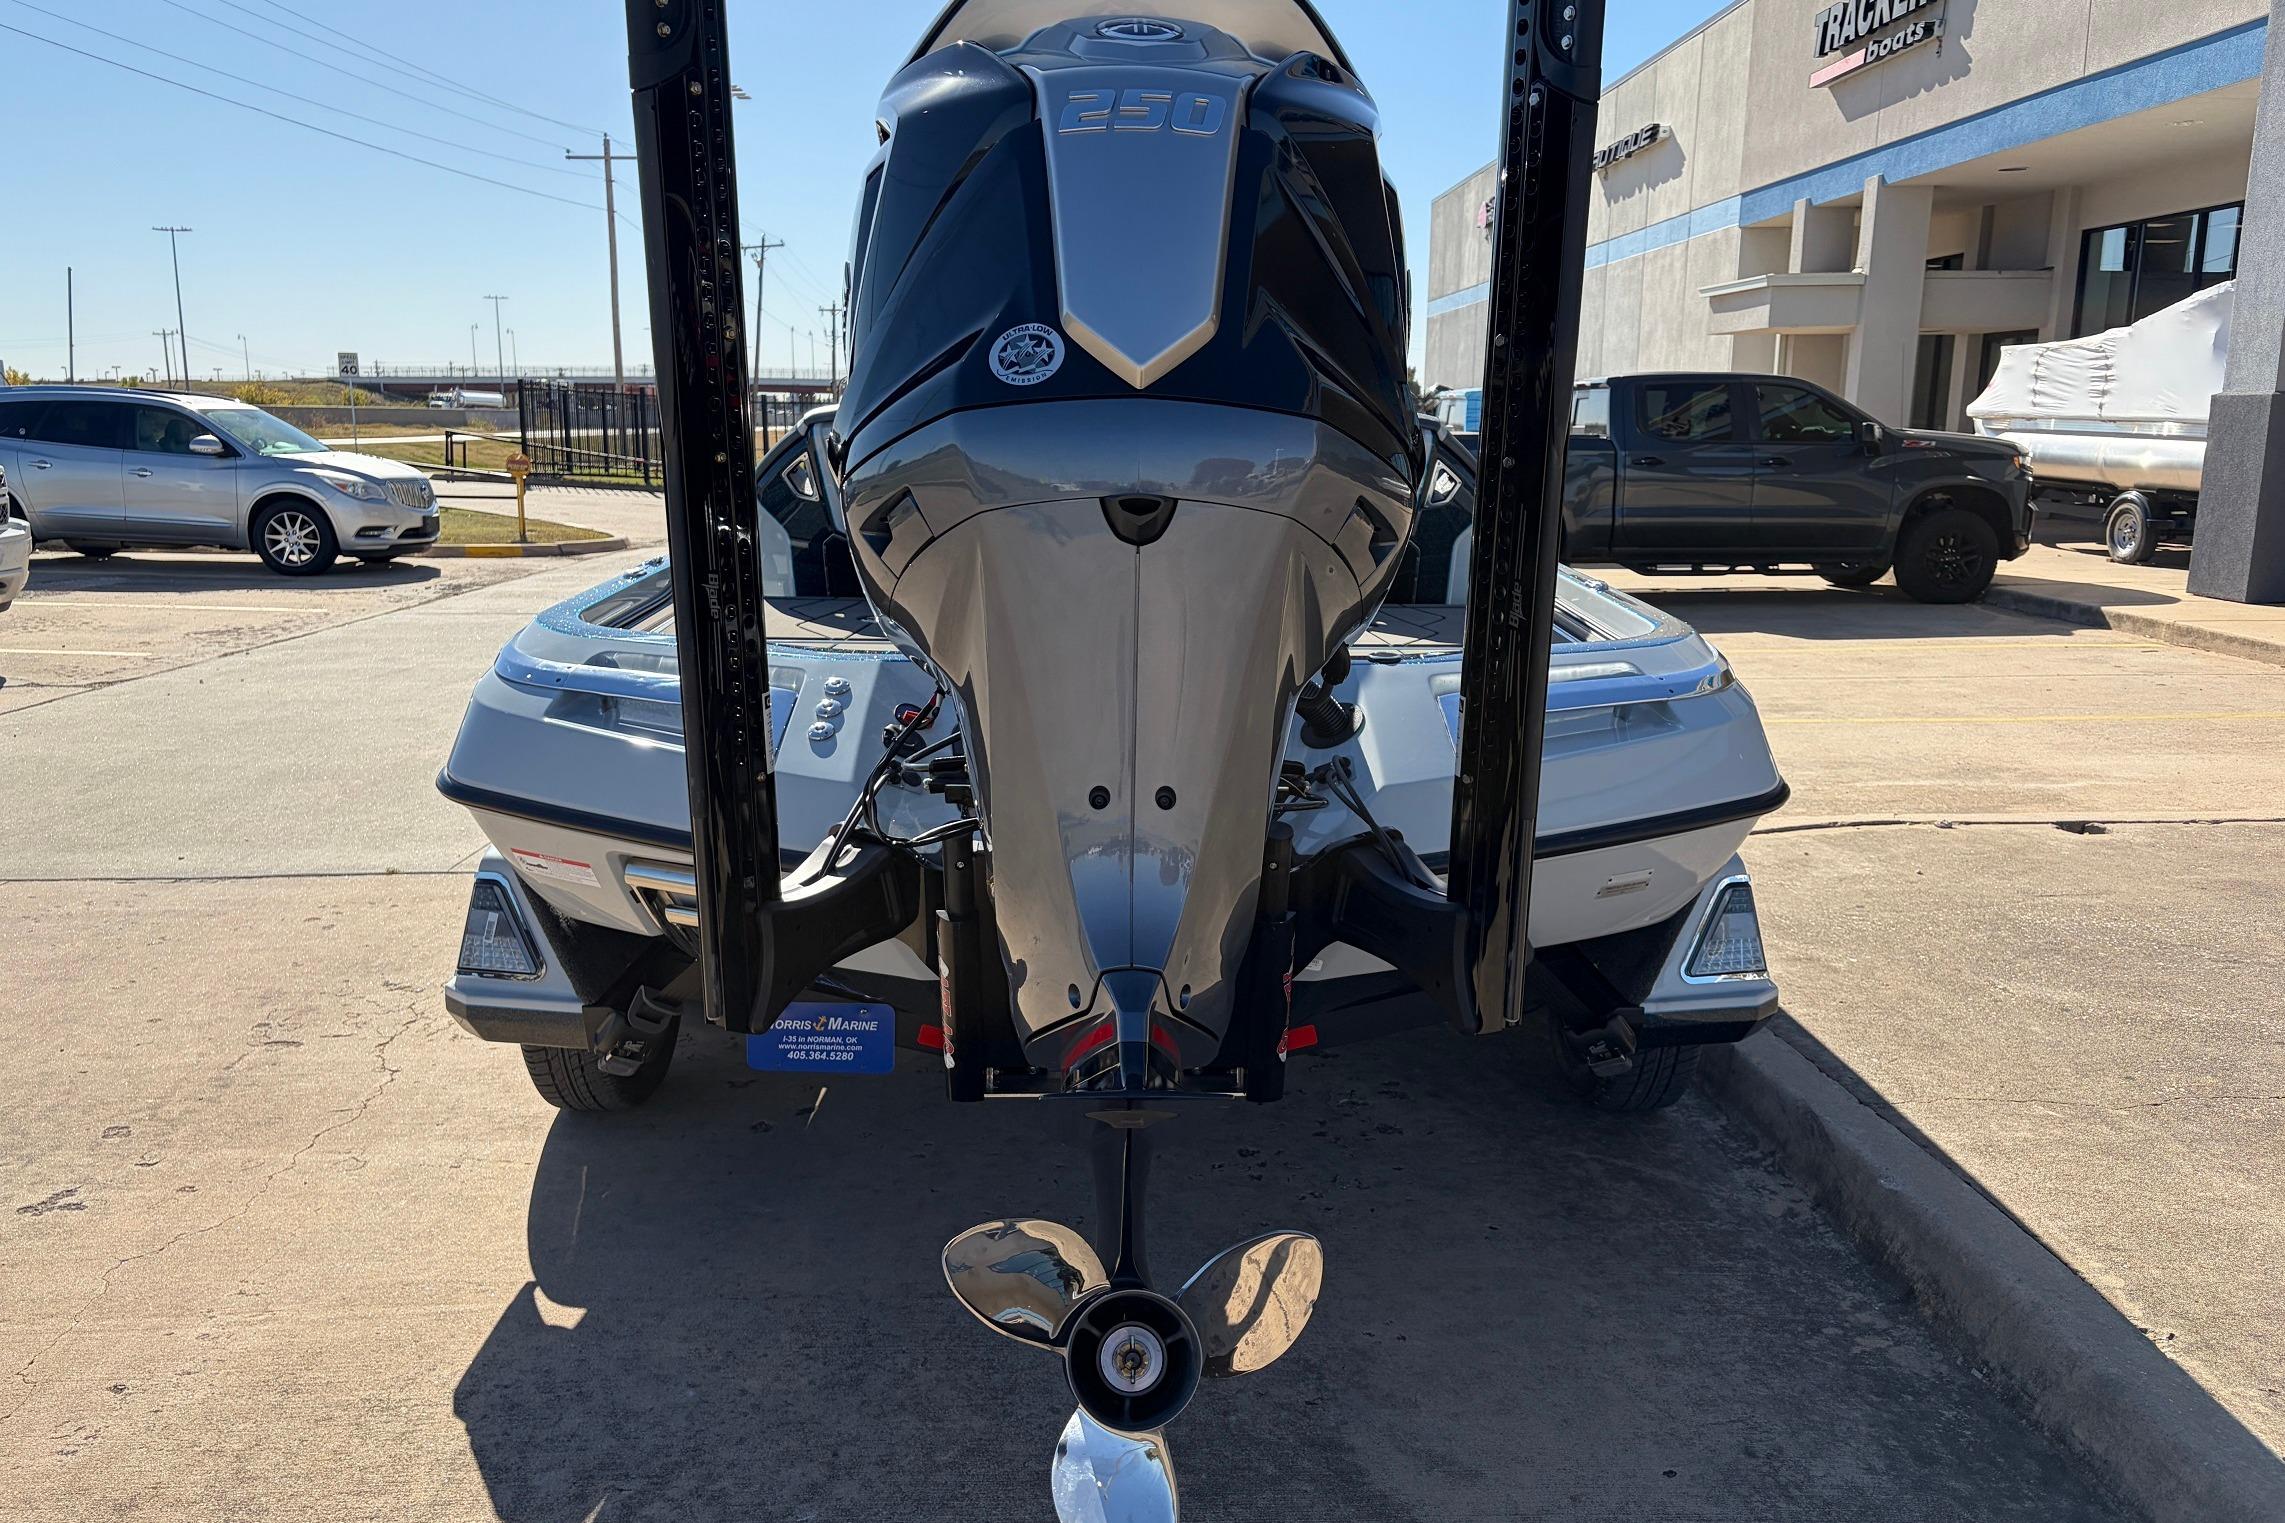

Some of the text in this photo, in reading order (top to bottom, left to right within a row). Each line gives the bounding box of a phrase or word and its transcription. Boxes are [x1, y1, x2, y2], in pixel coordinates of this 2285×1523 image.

[1814, 0, 1927, 58] TRACK
[1866, 21, 1925, 63] boats
[1059, 89, 1227, 136] 250
[1592, 124, 1654, 170] AUTIQUE
[341, 365, 358, 375] 40
[1005, 372, 1047, 384] EMISSION
[702, 573, 720, 620] Blade
[1508, 581, 1527, 629] Blade
[828, 1017, 878, 1031] MARINE
[778, 1043, 863, 1051] www.norrismarine.com
[783, 1035, 858, 1044] I-35 in NORMAN, OK
[787, 1051, 854, 1061] 405.364.5280
